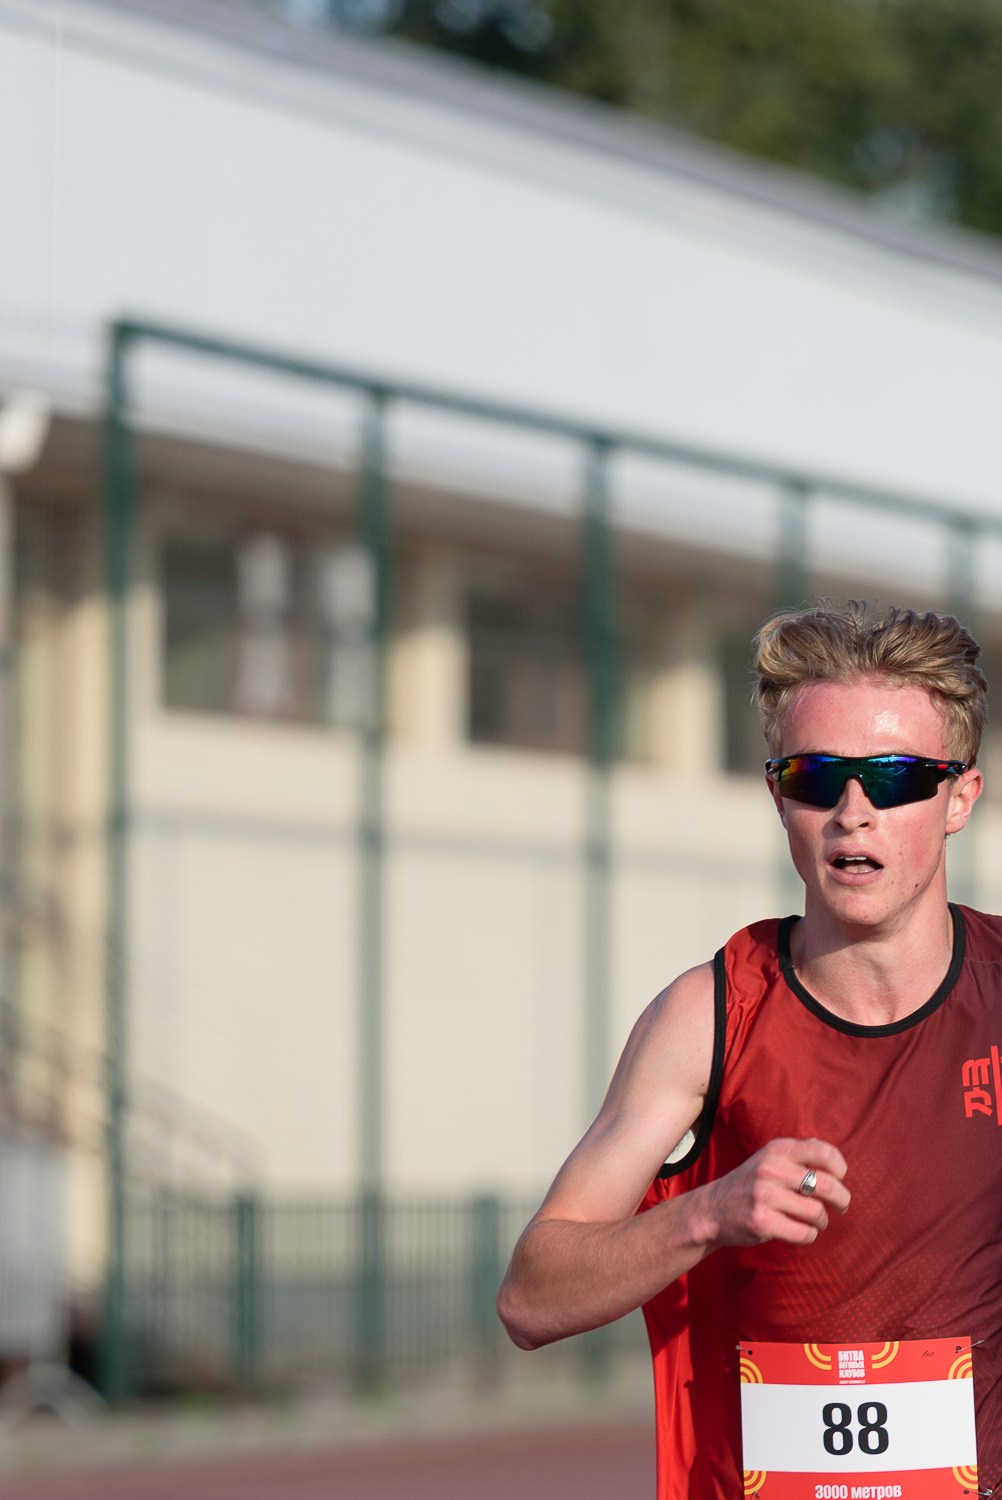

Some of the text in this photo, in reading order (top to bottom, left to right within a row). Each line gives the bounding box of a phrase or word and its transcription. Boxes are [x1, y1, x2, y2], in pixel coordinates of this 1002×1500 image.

[838, 1350, 864, 1361] БИТВА
[822, 1402, 889, 1456] 88
[815, 1484, 902, 1500] 3000 метров
